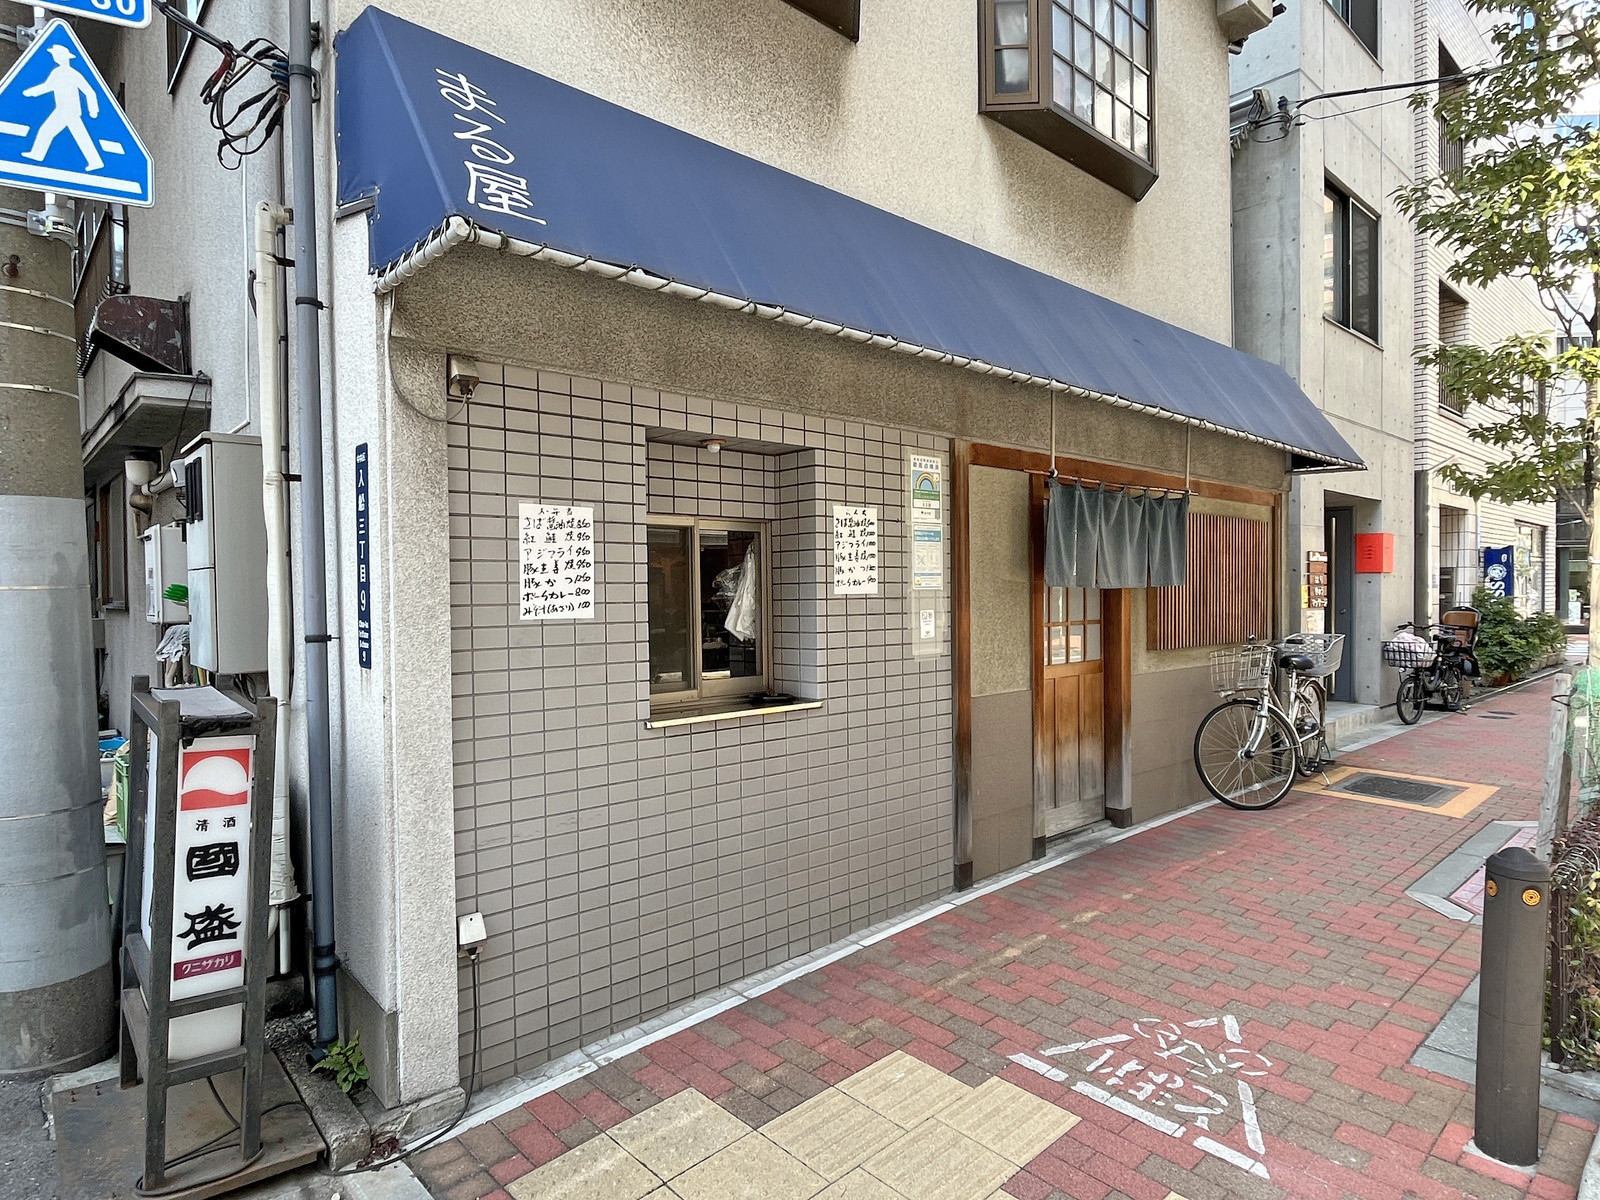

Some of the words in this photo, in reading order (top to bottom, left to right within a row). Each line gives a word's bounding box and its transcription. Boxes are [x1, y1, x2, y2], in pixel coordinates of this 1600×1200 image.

[434, 68, 548, 226] まる屋
[574, 587, 591, 597] 800
[577, 601, 591, 609] 100
[195, 816, 237, 832] 清酒
[181, 954, 235, 976] クニサカリ
